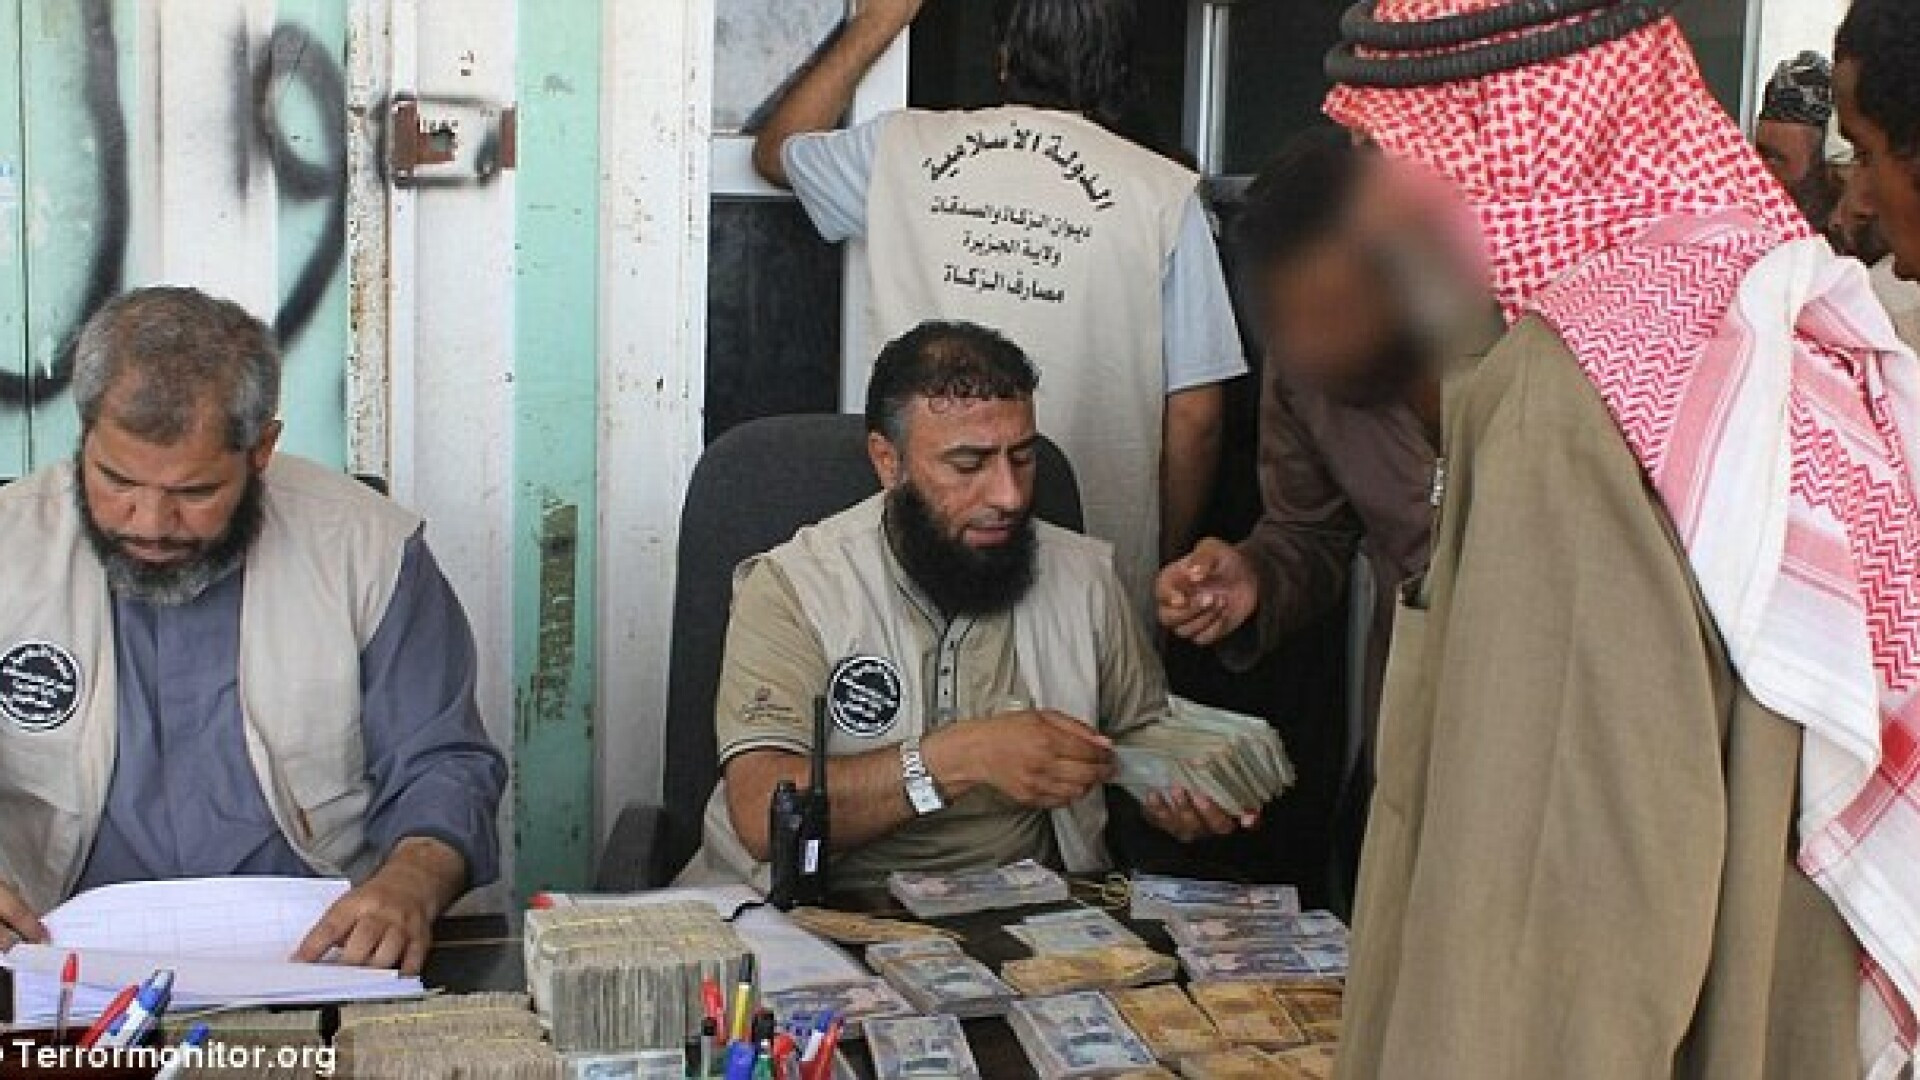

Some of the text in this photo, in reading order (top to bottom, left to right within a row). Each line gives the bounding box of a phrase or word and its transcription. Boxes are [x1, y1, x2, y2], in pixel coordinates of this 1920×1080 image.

[1043, 134, 1115, 211] الدولة
[1050, 217, 1091, 244] ديوان
[1022, 239, 1062, 268] ولاية
[943, 264, 1065, 304] مصارف الزكاة
